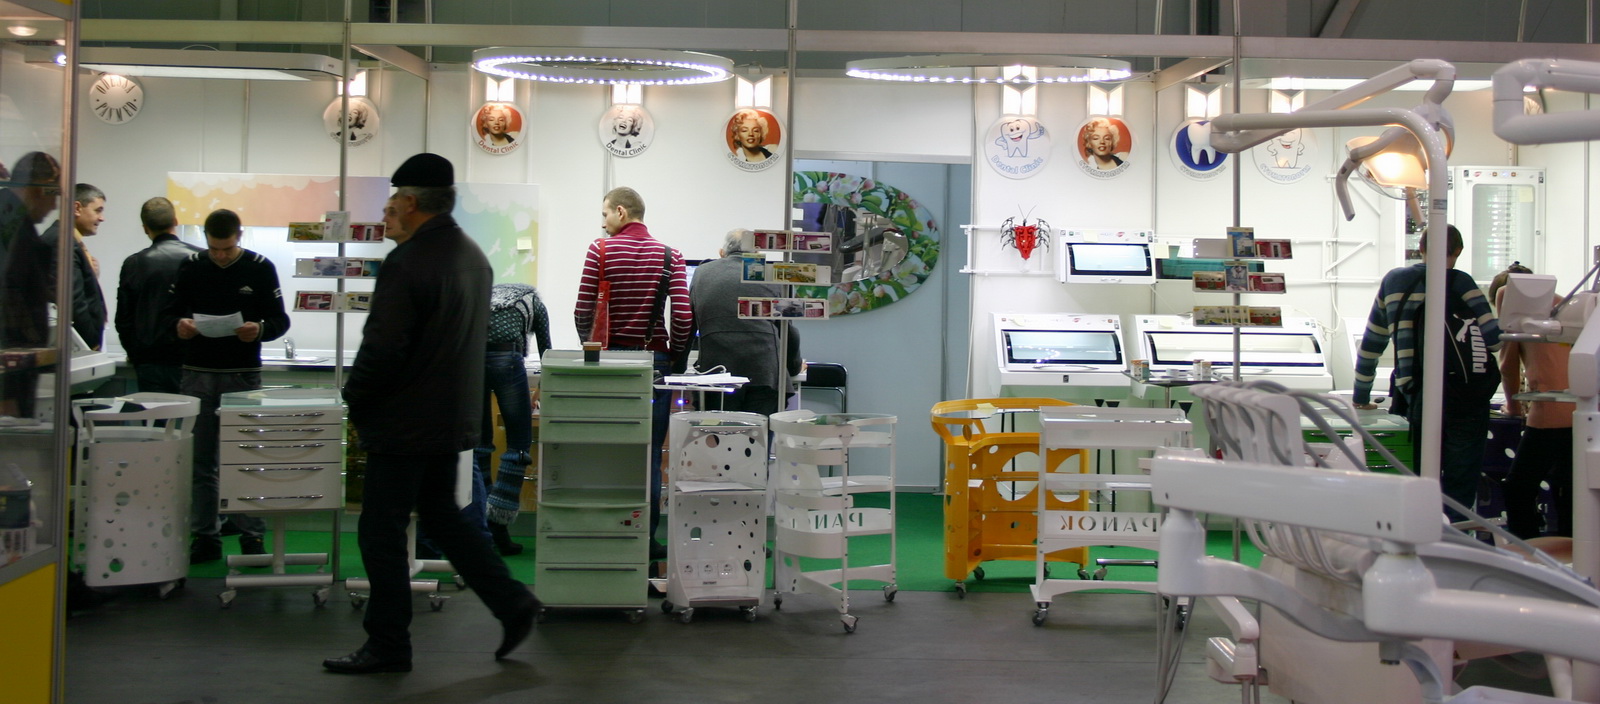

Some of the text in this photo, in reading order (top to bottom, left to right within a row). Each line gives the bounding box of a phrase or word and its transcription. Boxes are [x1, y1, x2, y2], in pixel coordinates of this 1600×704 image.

[478, 139, 519, 153] Dental Clinic
[606, 142, 647, 156] Dental Clinic
[991, 154, 1044, 174] Dental Clinic
[1469, 325, 1488, 373] PUMA
